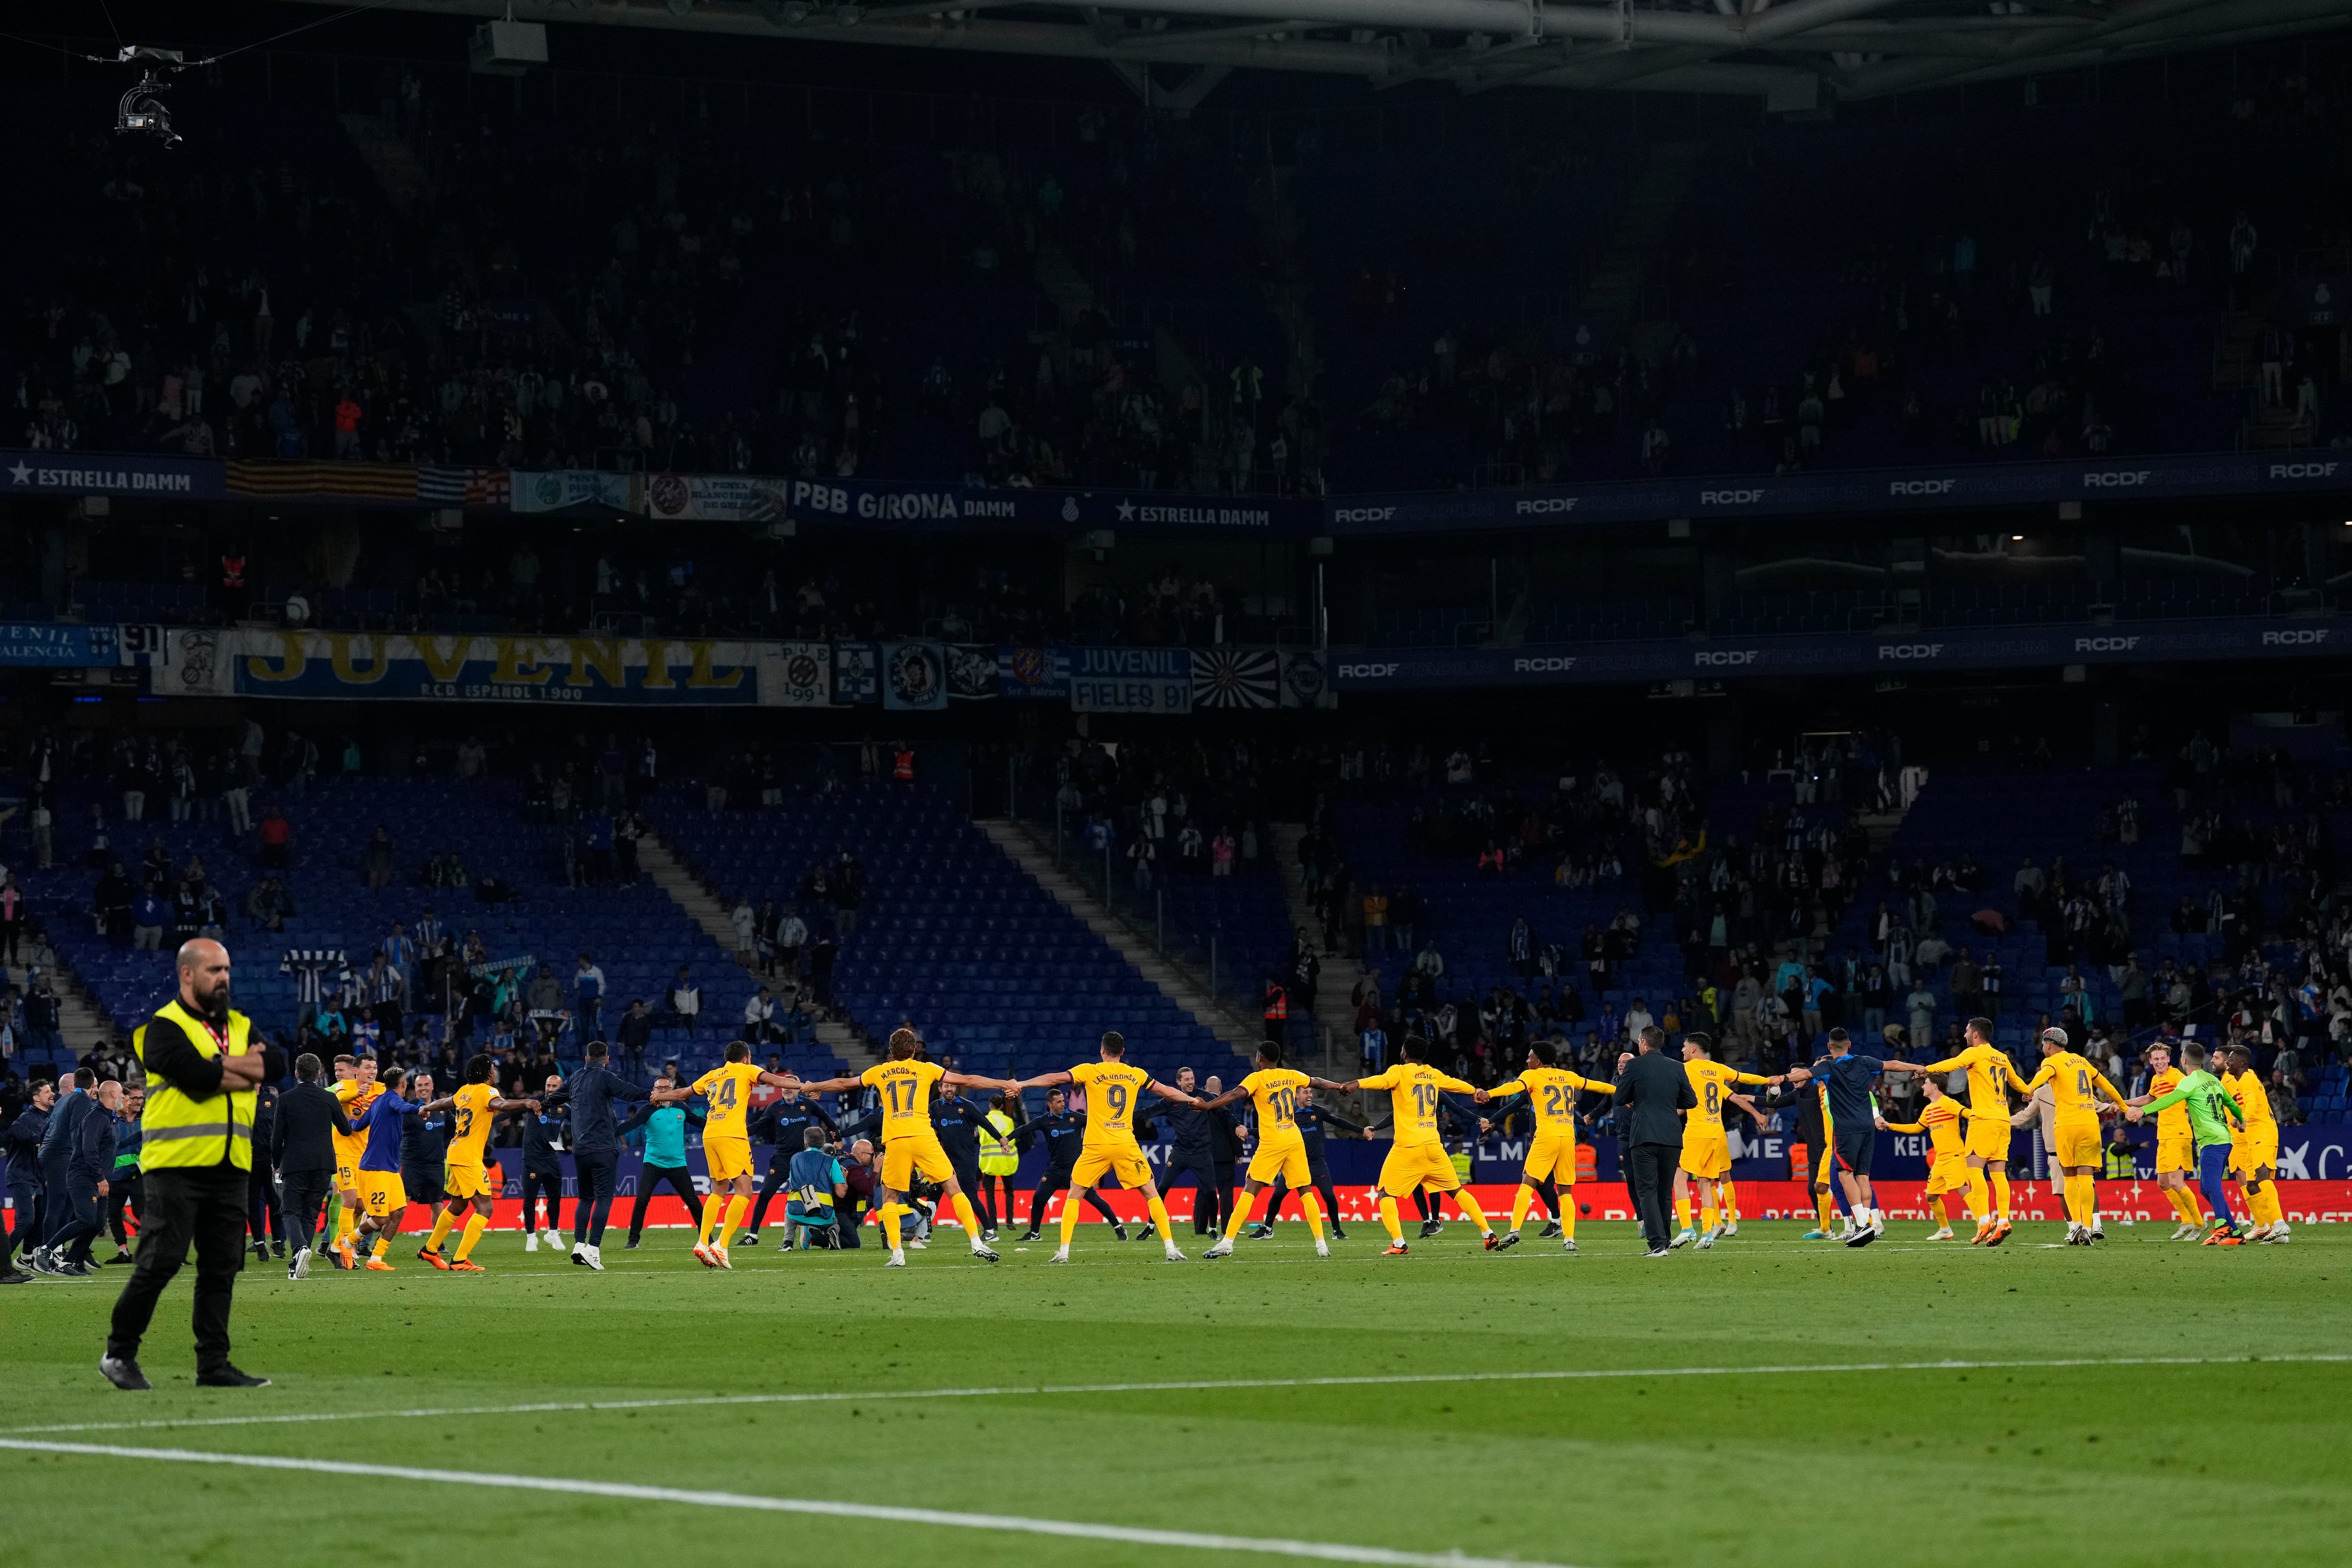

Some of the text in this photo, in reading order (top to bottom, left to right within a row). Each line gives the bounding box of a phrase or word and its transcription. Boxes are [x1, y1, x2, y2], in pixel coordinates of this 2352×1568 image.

[38, 469, 190, 491] ESTRELLA DAMM
[794, 481, 958, 519] PBB GIRONA
[964, 500, 1016, 517] DAMM
[1140, 506, 1269, 526] ESTRELLA DAMM
[247, 632, 745, 689] JUVENIL
[1081, 649, 1180, 674] JUVENIL
[1076, 683, 1188, 708] FIELES 91
[881, 1067, 910, 1080] MARCOS
[1265, 1080, 1281, 1090] ANSU
[2077, 1069, 2091, 1100] 4
[885, 1079, 917, 1113] 17
[1107, 1085, 1126, 1120] 9
[1268, 1088, 1294, 1124] 10
[1411, 1084, 1435, 1118] 19
[1543, 1085, 1574, 1117] 28
[1705, 1082, 1720, 1115] 8
[339, 1166, 351, 1178] 15
[371, 1192, 386, 1204] 22
